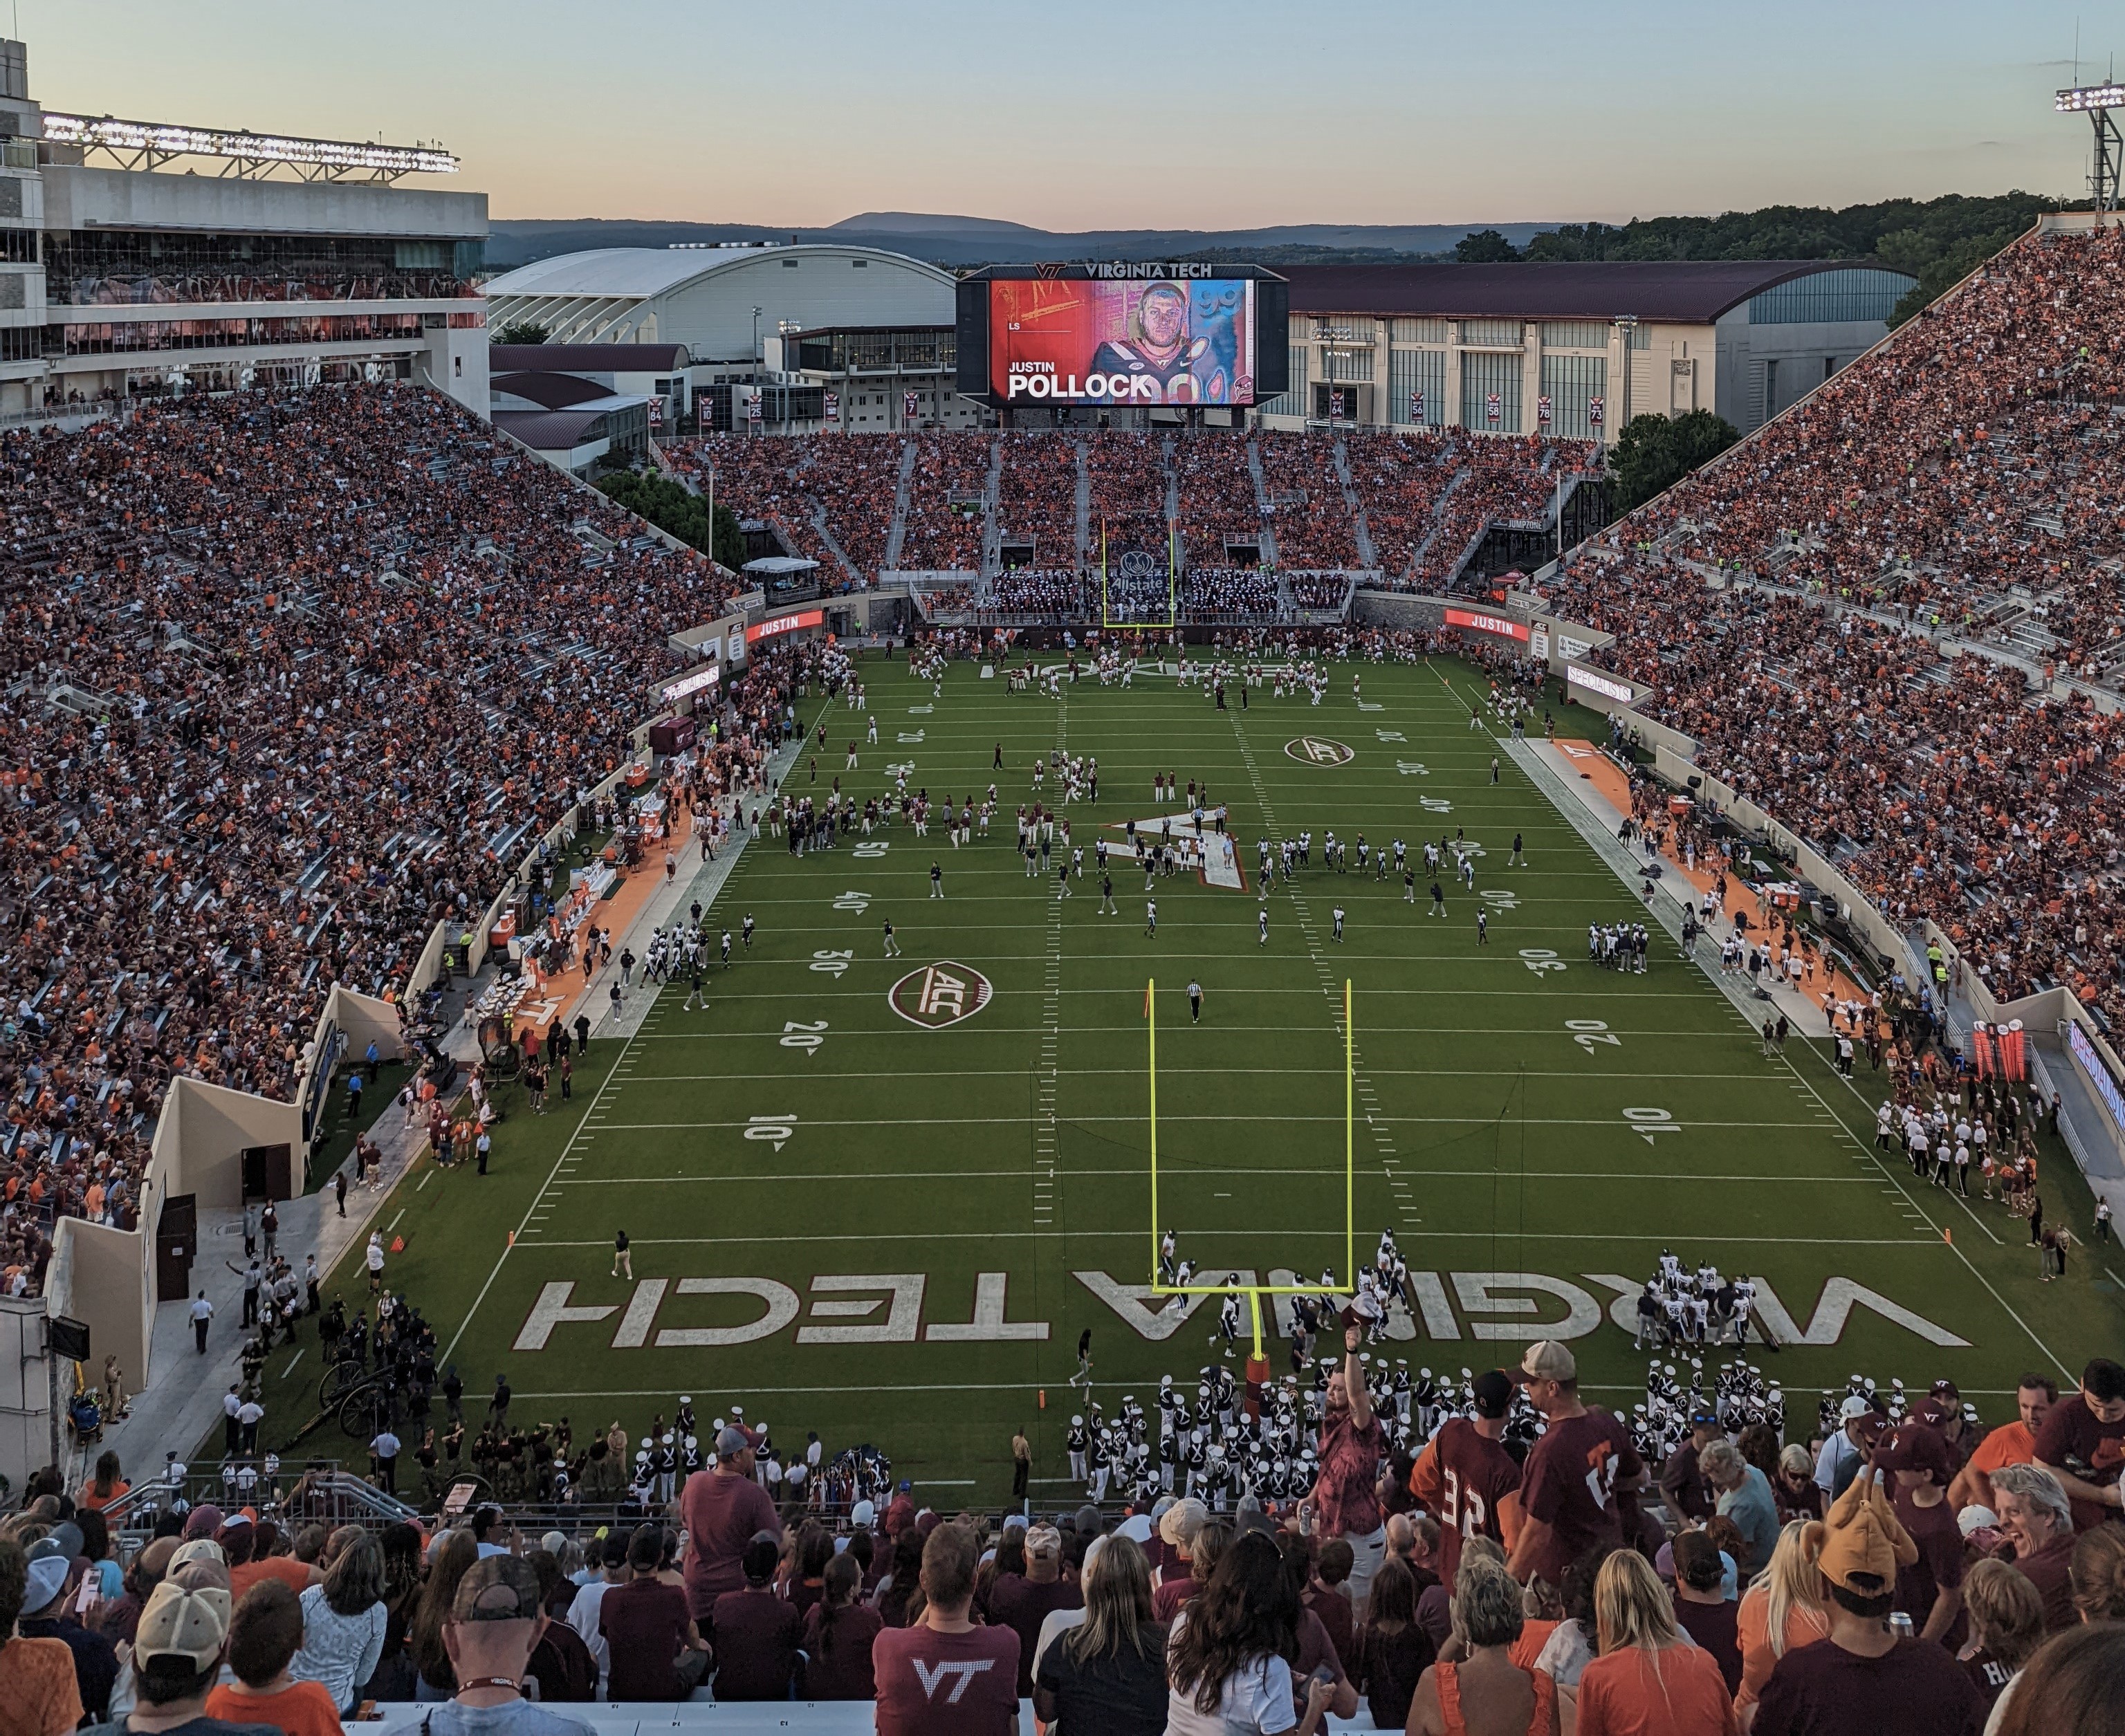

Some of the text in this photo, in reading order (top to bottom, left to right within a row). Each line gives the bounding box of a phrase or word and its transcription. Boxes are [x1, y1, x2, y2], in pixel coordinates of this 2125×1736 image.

[1035, 262, 1068, 279] VT
[1085, 263, 1212, 278] VIRGINIA TECH
[1009, 322, 1020, 331] LS
[1009, 362, 1055, 373] JUSTIN
[1009, 374, 1152, 398] POLLOCK
[703, 411, 711, 420] 10
[751, 408, 762, 418] 25
[909, 404, 915, 414] 7
[1332, 405, 1343, 414] 64
[1413, 405, 1423, 414] 56
[1489, 407, 1499, 416] 58
[1539, 409, 1550, 418] 78
[1591, 410, 1602, 419] 73
[650, 412, 662, 421] 84
[1508, 519, 1543, 530] JUMPZONE
[1111, 578, 1163, 591] Allstate
[1493, 590, 1505, 600] 40
[760, 615, 799, 636] JUSTIN
[1471, 615, 1513, 635] JUSTIN
[1570, 668, 1629, 702] SPECIALISTS
[896, 731, 926, 742] 20
[1375, 731, 1408, 742] 20
[1396, 763, 1430, 775] 30
[1419, 800, 1455, 813] 40
[852, 842, 890, 858] 50
[832, 891, 872, 909] 40
[1479, 890, 1522, 909] 40
[809, 949, 854, 971] 30
[1518, 949, 1567, 971] 30
[928, 970, 966, 1017] ACC
[779, 1020, 829, 1046] 20
[1564, 1019, 1622, 1046] 20
[1622, 1107, 1682, 1132] 10
[744, 1114, 798, 1140] 10
[511, 1271, 1051, 1351] TECH
[1669, 1307, 1680, 1315] 56
[1924, 1412, 1940, 1423] VT
[1442, 1467, 1485, 1540] 32
[910, 1658, 996, 1703] VT
